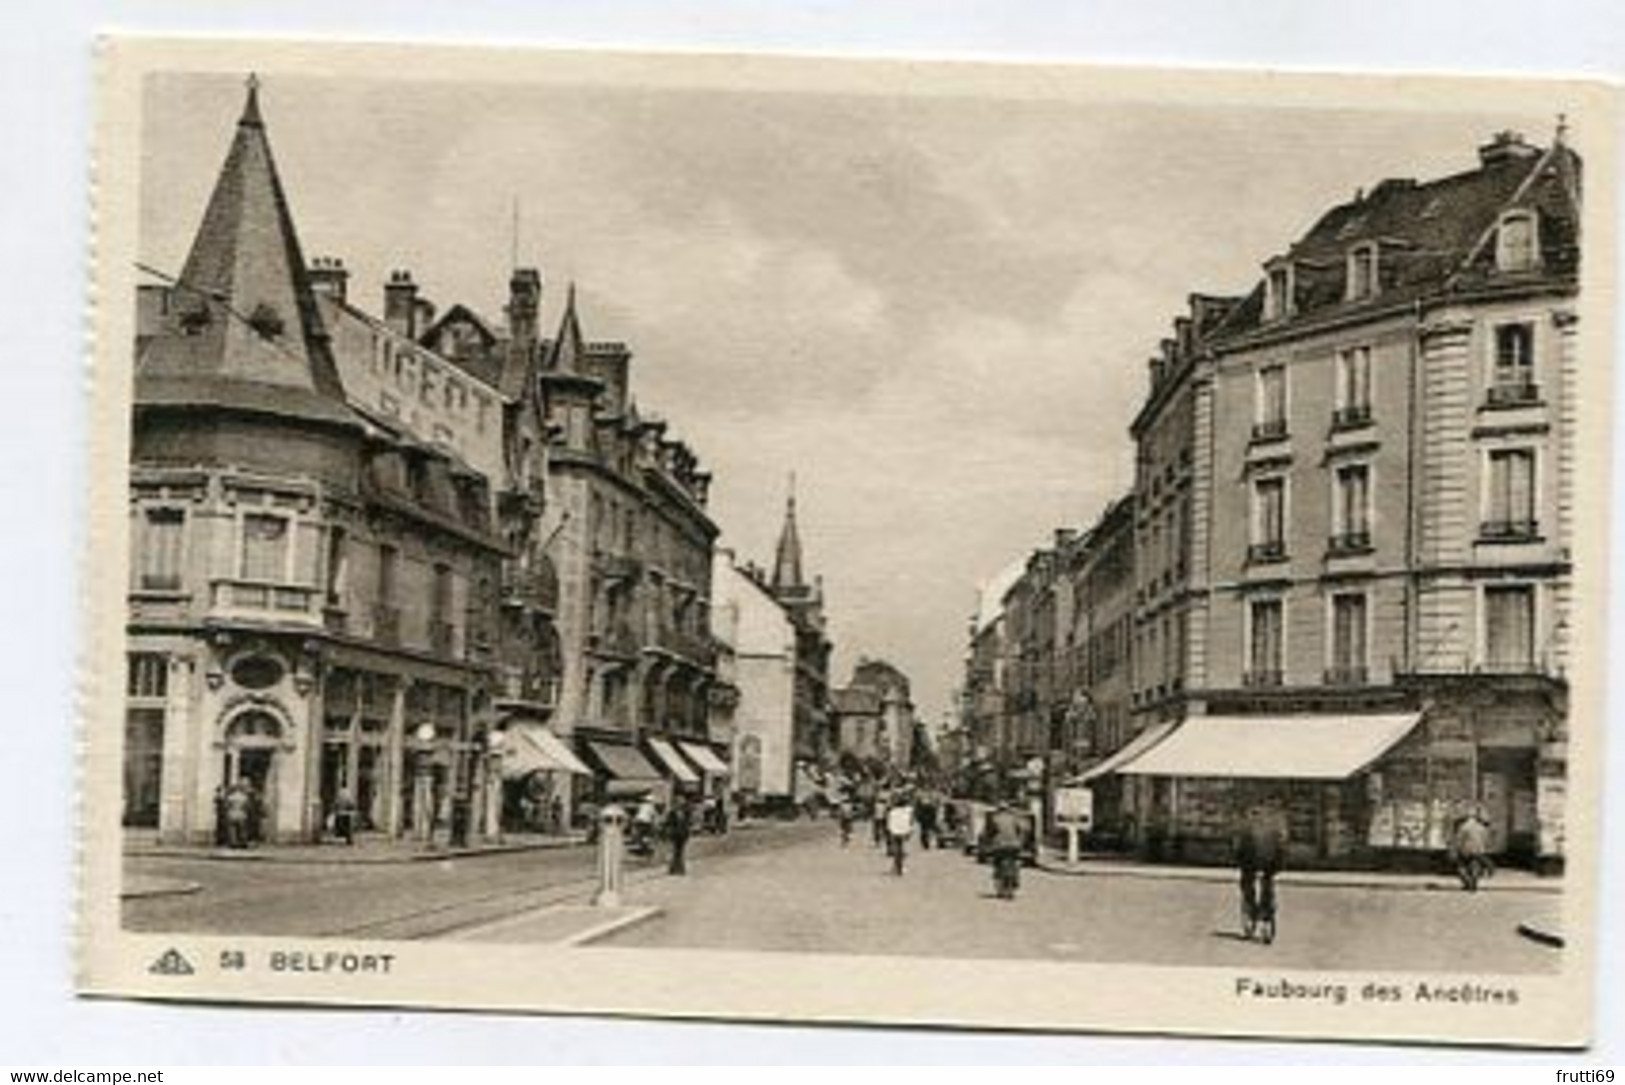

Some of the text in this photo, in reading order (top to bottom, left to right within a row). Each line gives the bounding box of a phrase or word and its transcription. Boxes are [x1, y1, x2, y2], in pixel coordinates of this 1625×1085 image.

[270, 951, 395, 973] BELFORT
[1236, 978, 1519, 1004] Faubourg des Ancêtres
